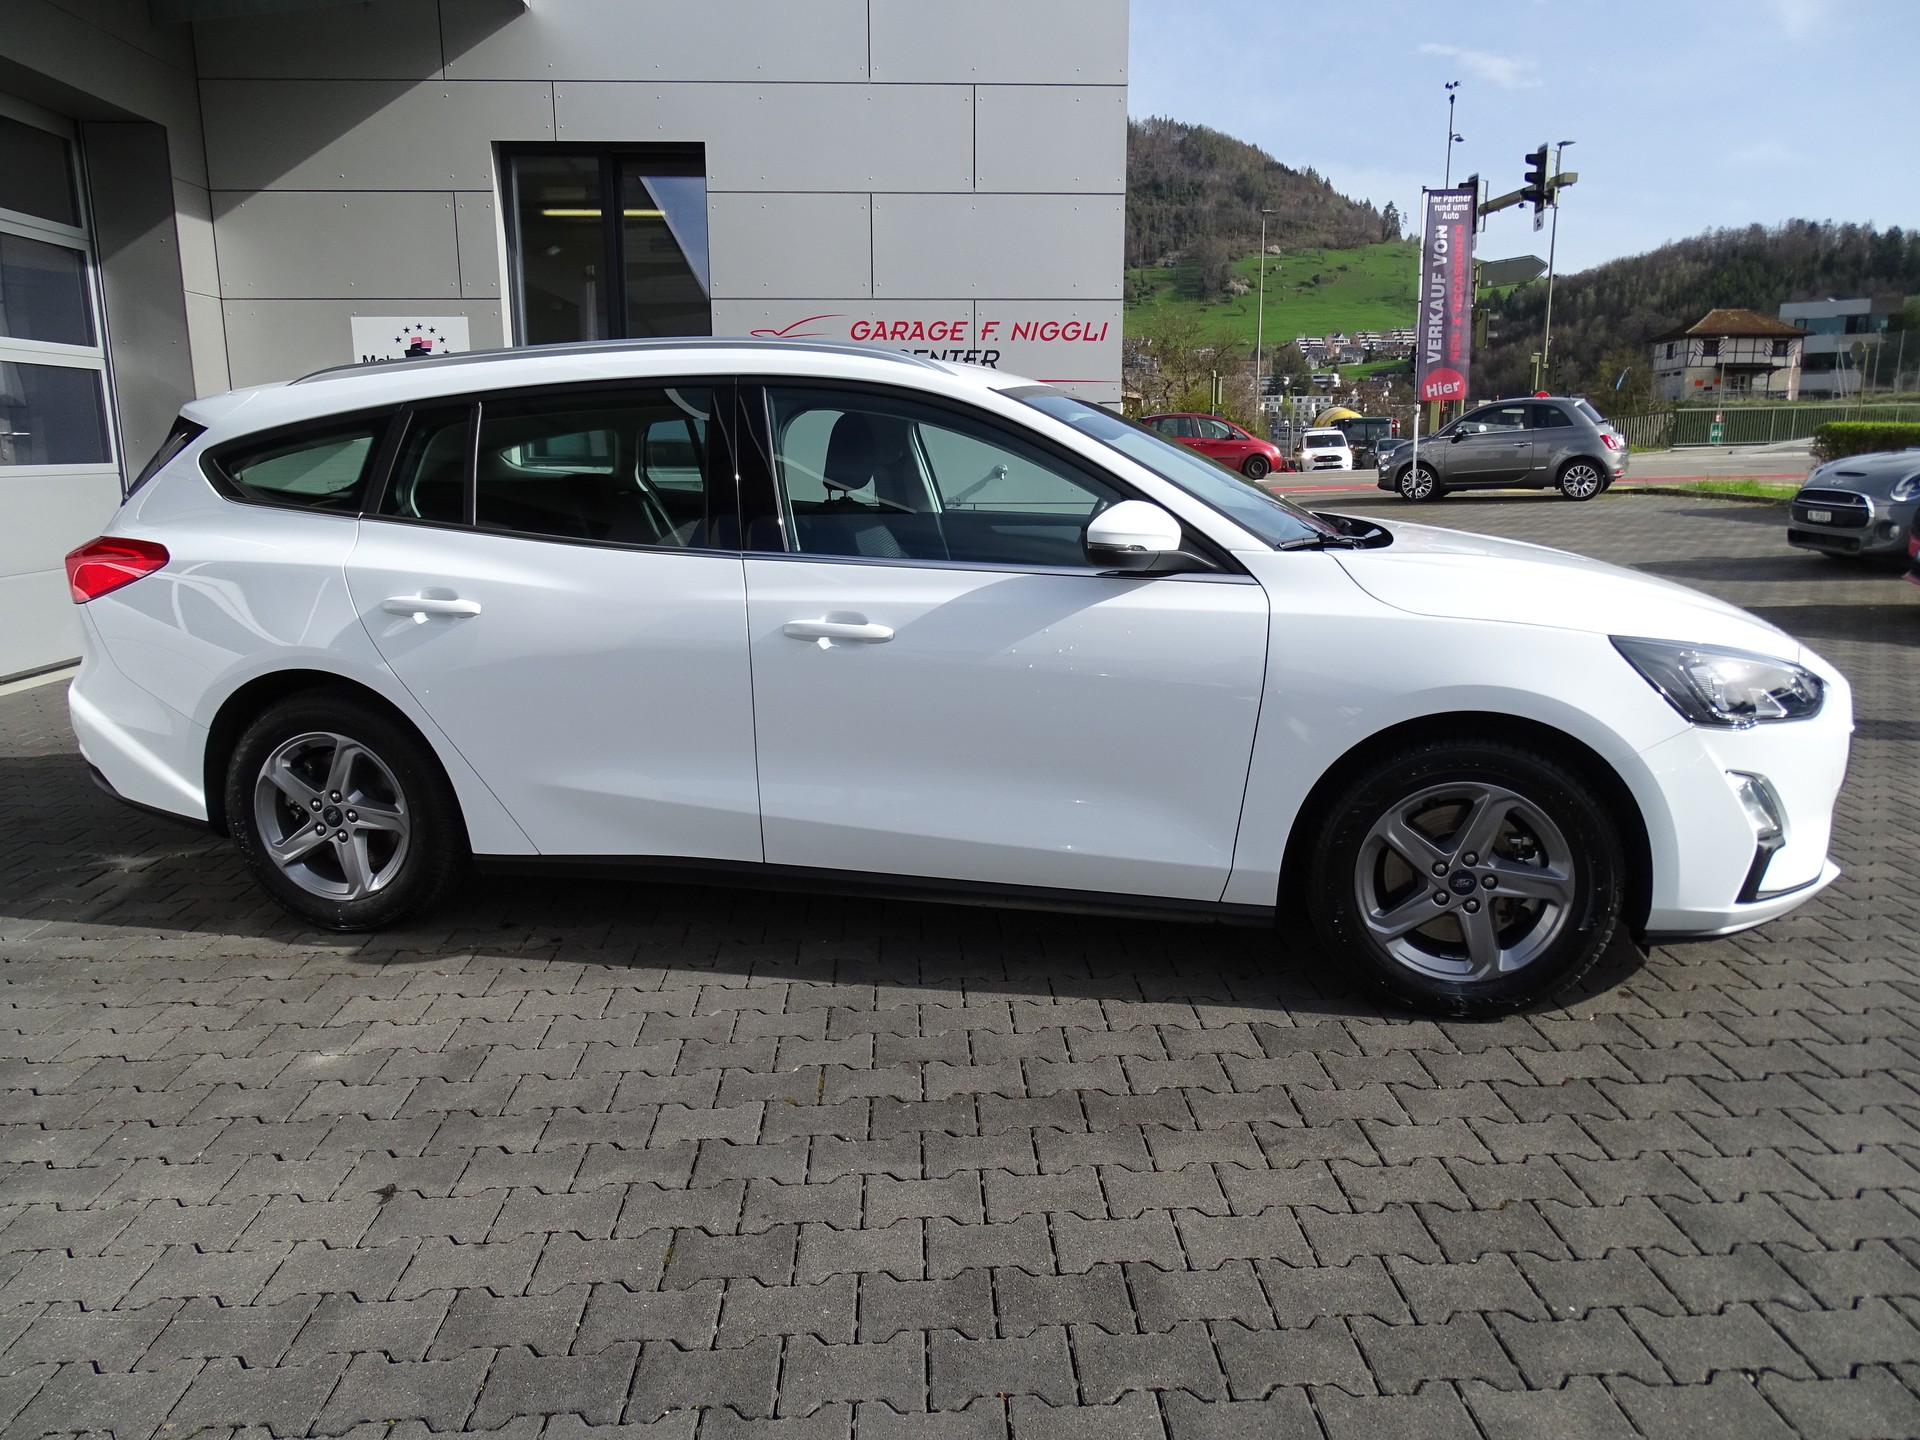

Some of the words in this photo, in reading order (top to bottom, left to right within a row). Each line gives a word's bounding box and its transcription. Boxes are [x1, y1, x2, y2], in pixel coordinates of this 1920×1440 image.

[1434, 203, 1451, 211] rund
[1452, 203, 1469, 211] ums
[1443, 195, 1472, 203] Partner
[1442, 211, 1460, 220] Auto
[1432, 225, 1448, 267] VON
[1452, 224, 1464, 314] OCCASIONEN
[1426, 272, 1446, 364] VERKAUF
[1451, 316, 1463, 326] &
[850, 320, 969, 341] GARAGE
[980, 321, 1001, 341] F.
[1010, 321, 1109, 341] NIGGLI
[1425, 381, 1460, 398] Hier
